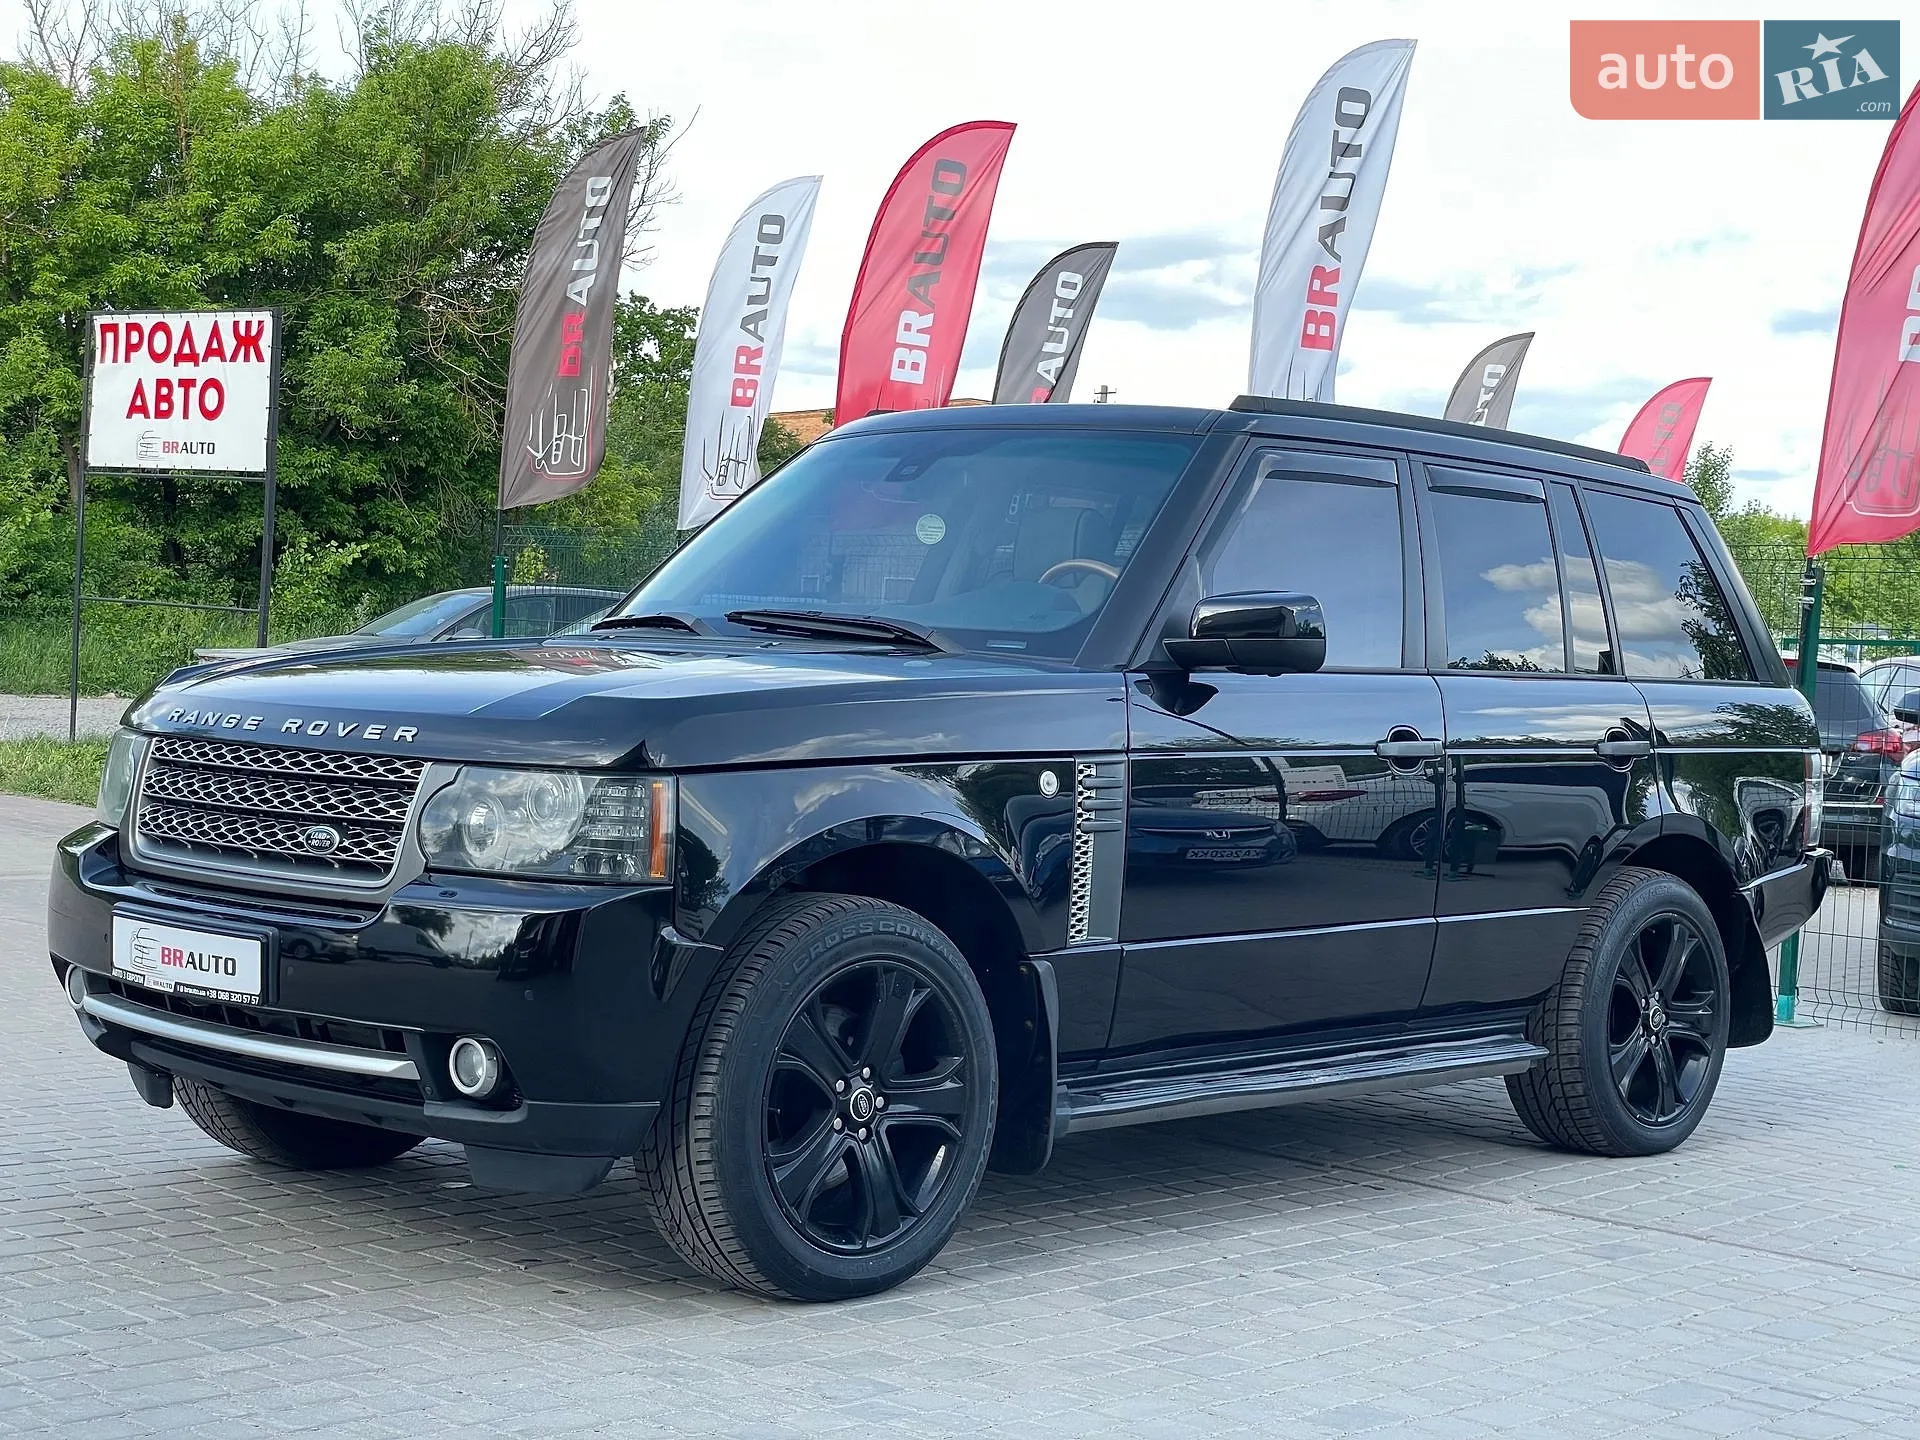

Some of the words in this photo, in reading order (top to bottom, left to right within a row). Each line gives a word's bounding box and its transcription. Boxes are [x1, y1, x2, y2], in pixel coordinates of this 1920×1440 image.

[1300, 86, 1372, 352] BRAUTO
[558, 176, 613, 377] BRAUTO
[890, 158, 968, 385] BRAUTO
[730, 213, 786, 407] BRAUTO
[99, 320, 265, 368] ПРОДАЖ
[125, 377, 226, 421] АВТО
[162, 440, 216, 455] BRAUTO
[167, 707, 264, 731] RANGE
[281, 717, 419, 743] ROVER
[160, 946, 237, 977] BRAUTO
[242, 994, 251, 1004] 57
[251, 996, 260, 1006] 57
